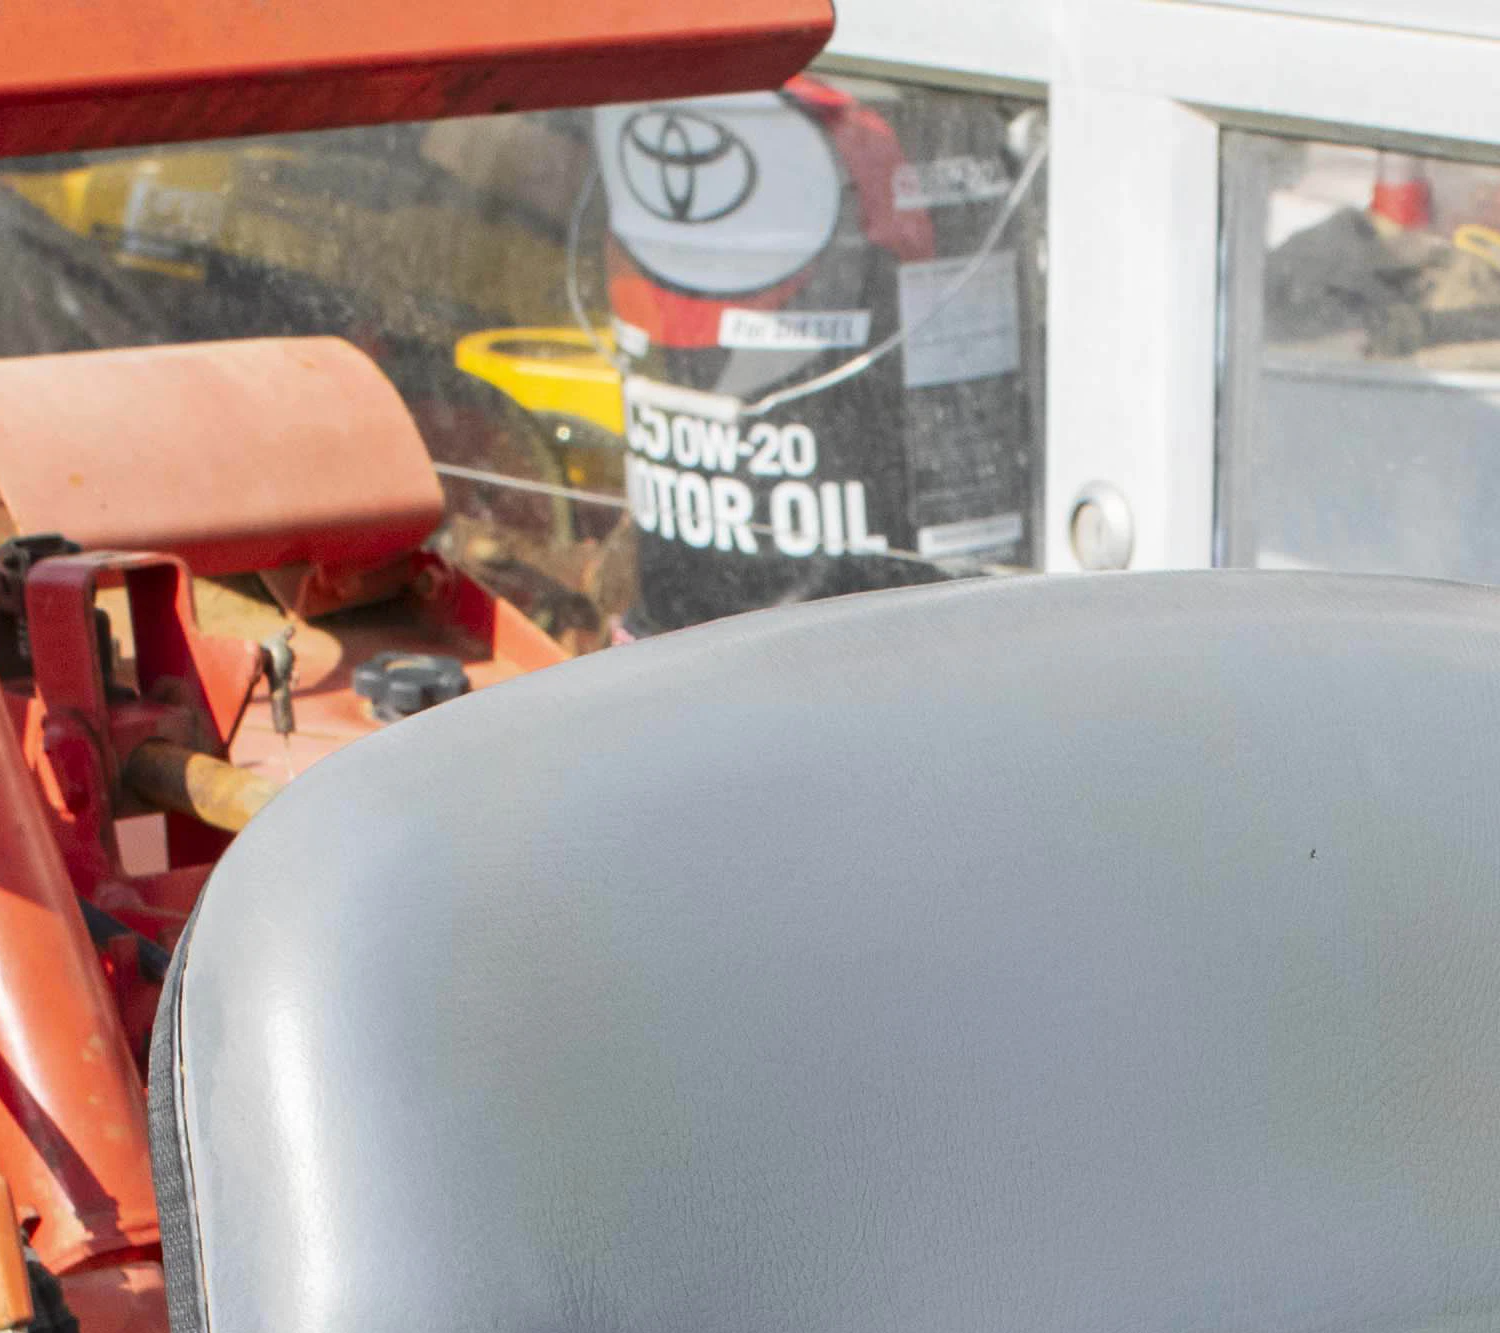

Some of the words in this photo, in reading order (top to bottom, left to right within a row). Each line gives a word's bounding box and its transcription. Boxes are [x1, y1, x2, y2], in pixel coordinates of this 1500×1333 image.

[671, 415, 817, 478] 0W-20
[624, 452, 760, 555] OTOR
[769, 480, 889, 558] OIL
